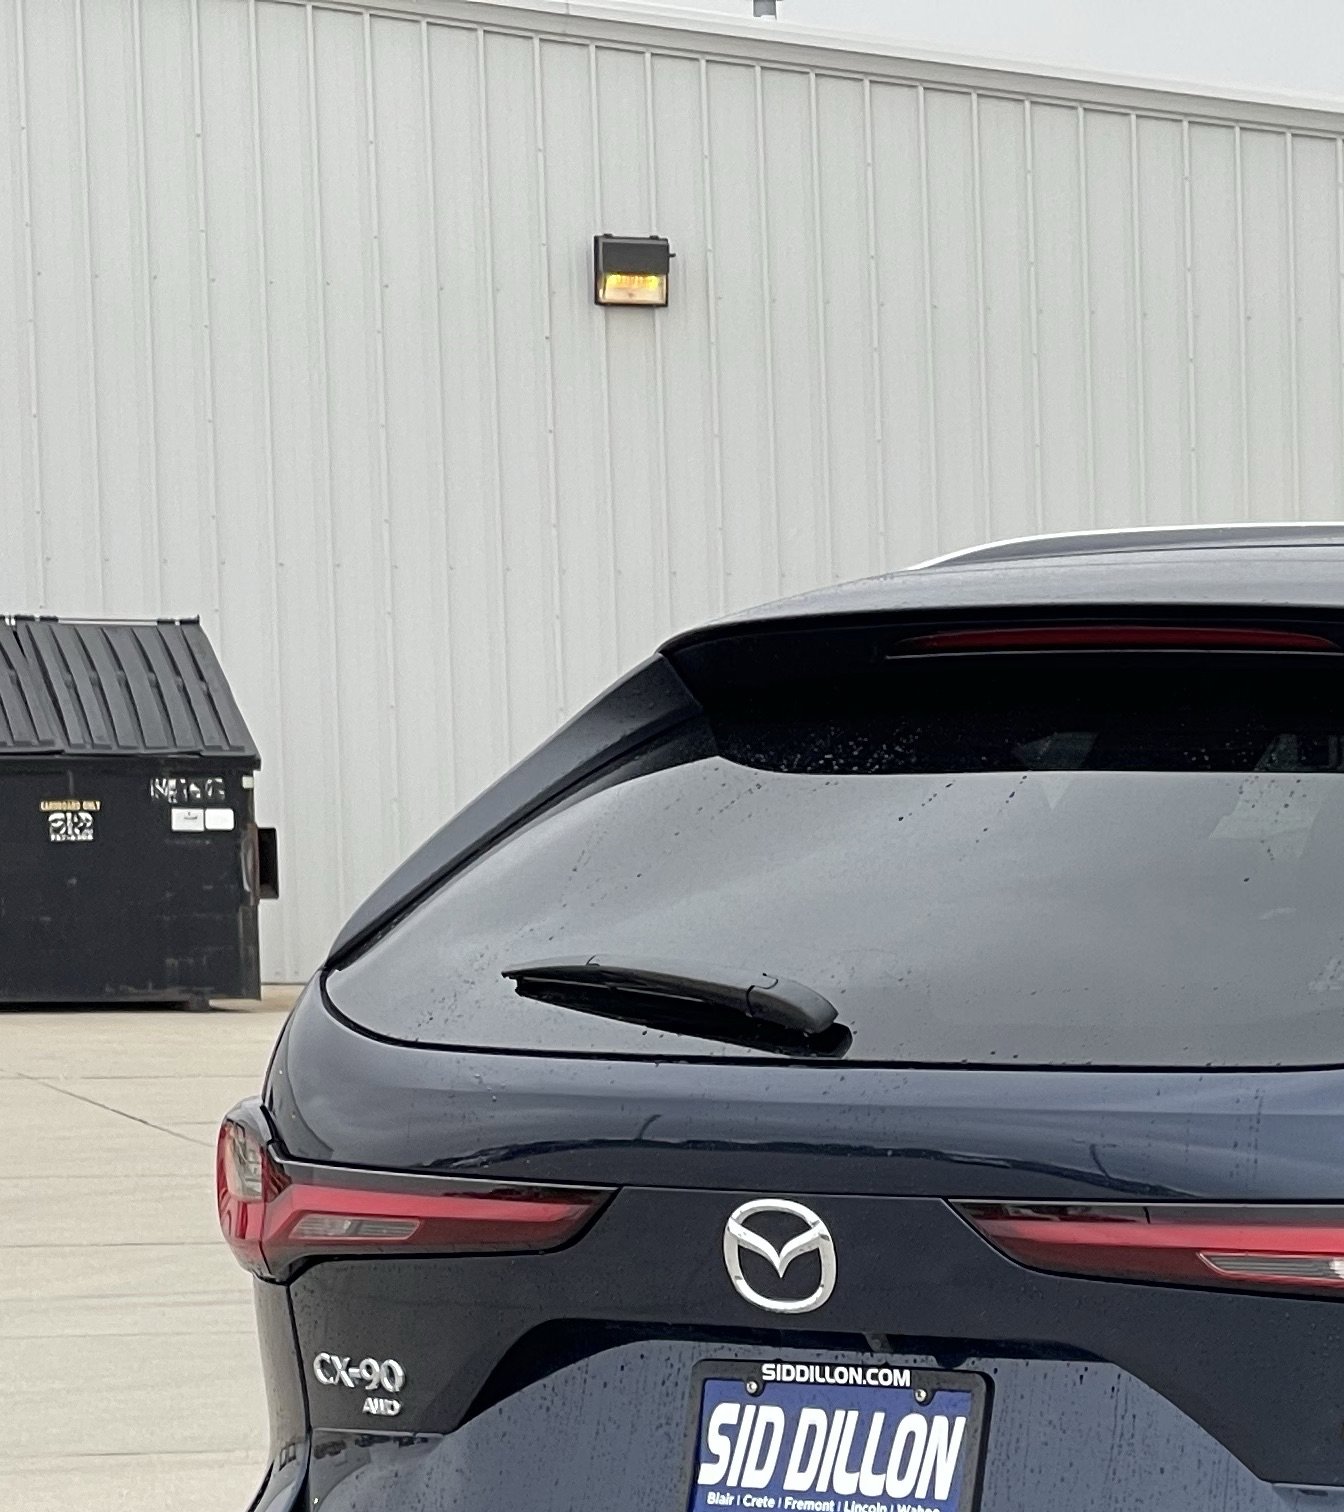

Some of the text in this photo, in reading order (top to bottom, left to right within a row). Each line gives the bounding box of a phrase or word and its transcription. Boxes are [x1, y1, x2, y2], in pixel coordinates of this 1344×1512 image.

[313, 1352, 405, 1393] CX-90
[761, 1363, 911, 1387] SIDDILLON.COM
[698, 1402, 967, 1501] SID DILLON
[707, 1491, 735, 1506] Blair
[742, 1494, 775, 1509] Crete
[783, 1496, 835, 1512] Fremont
